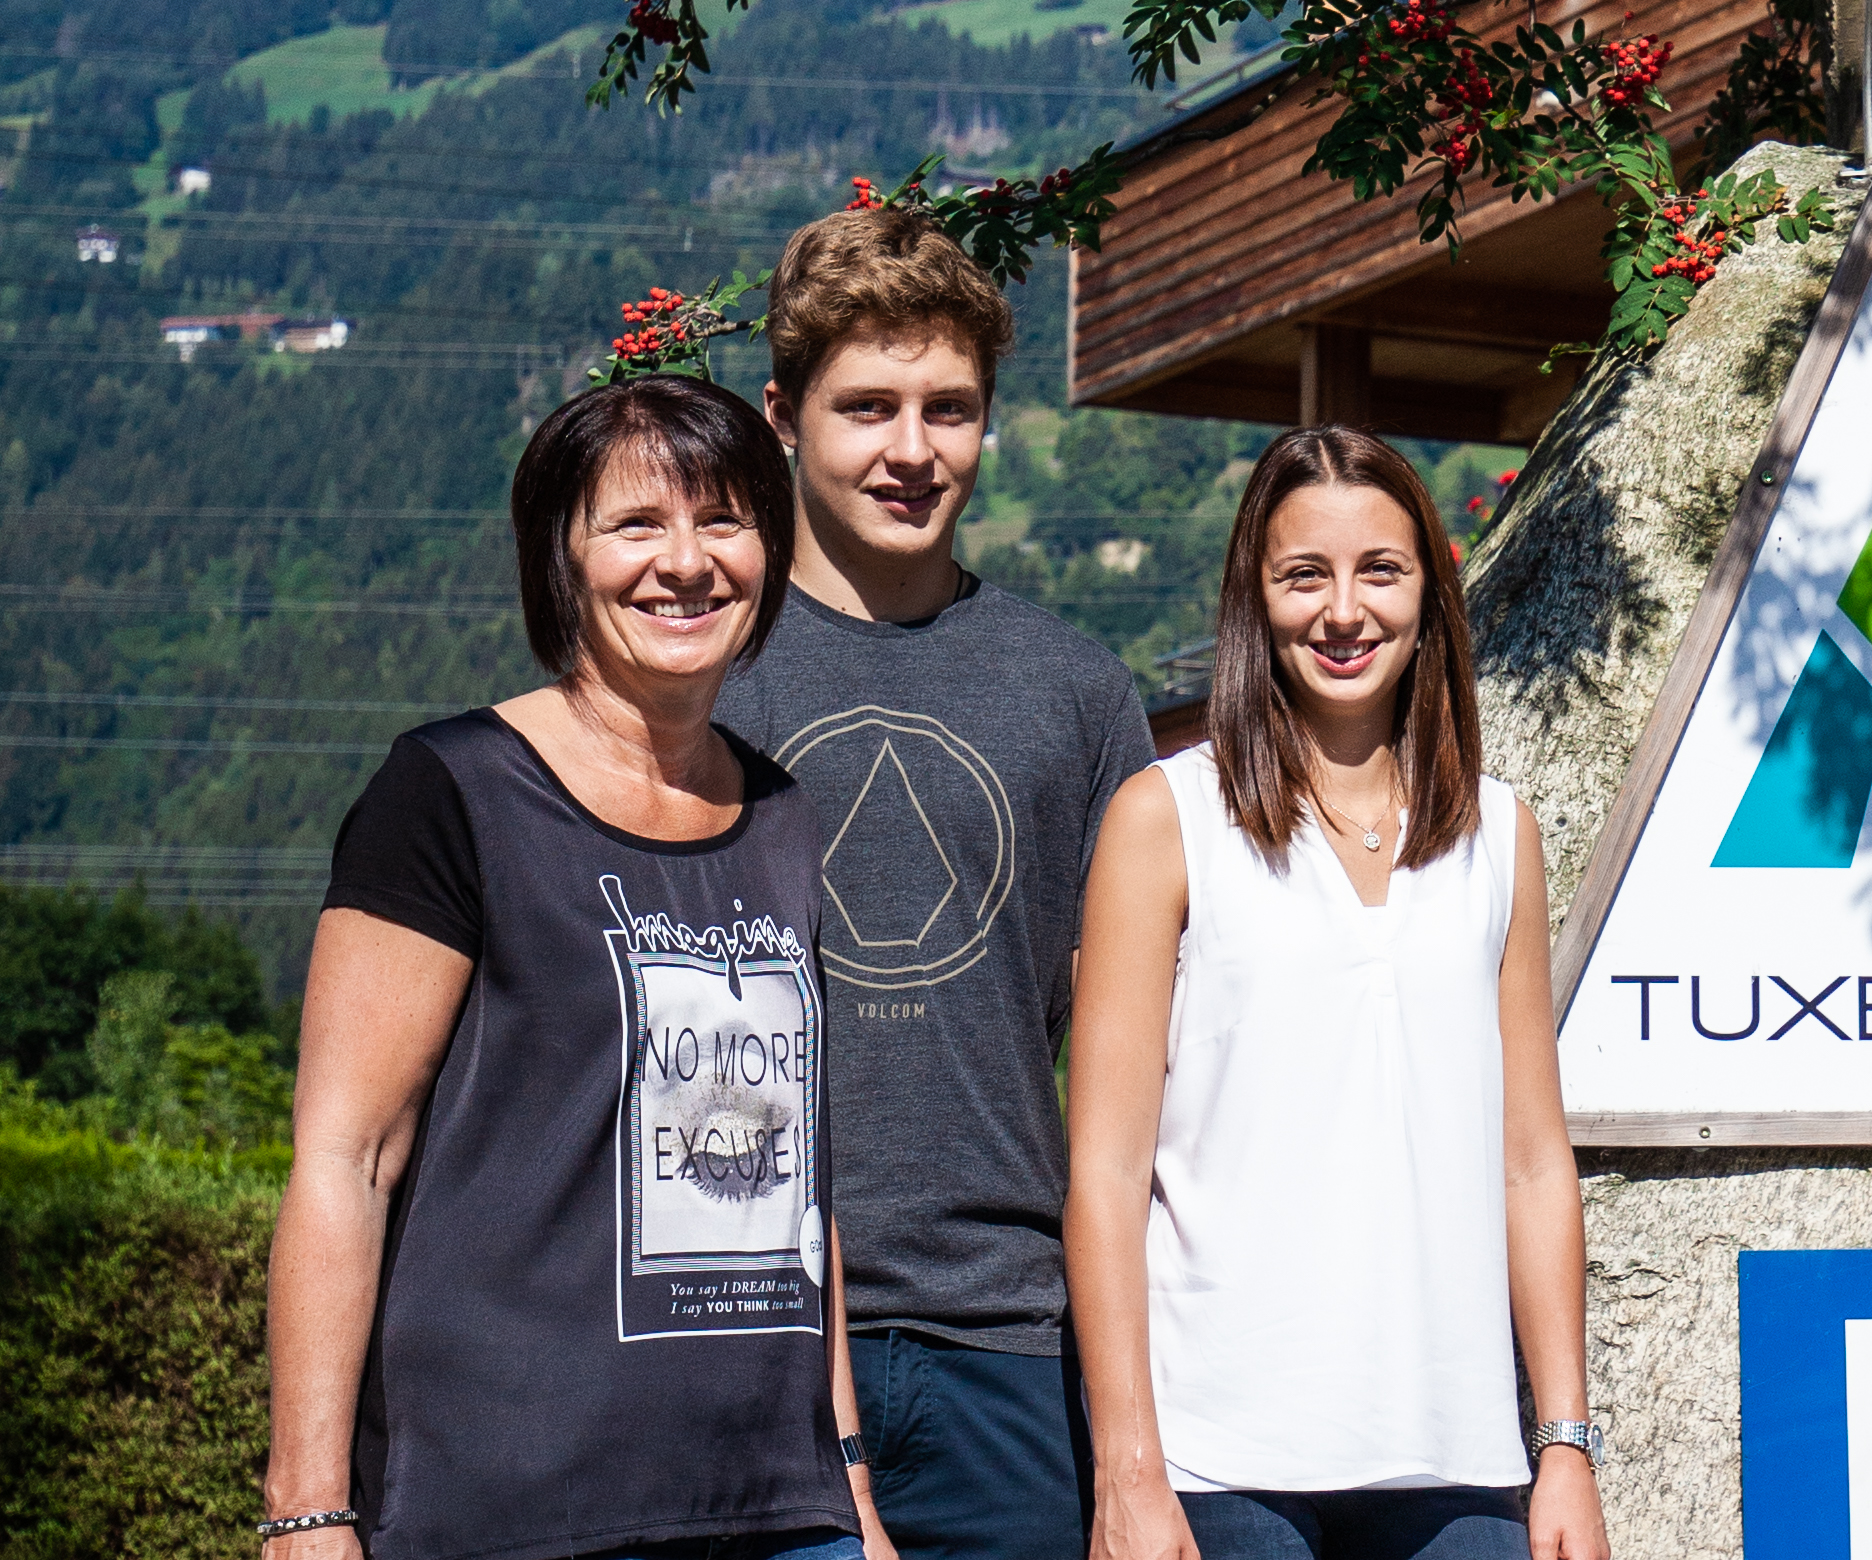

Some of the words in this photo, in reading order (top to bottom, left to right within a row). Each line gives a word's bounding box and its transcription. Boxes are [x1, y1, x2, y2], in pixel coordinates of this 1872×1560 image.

[599, 874, 807, 1002] Imagine
[857, 1002, 926, 1019] VOLCOM
[641, 1027, 699, 1082] NO
[714, 1031, 806, 1086] MORE
[655, 1125, 802, 1186] EXCUSES
[670, 1283, 694, 1296] You
[698, 1285, 719, 1299] say
[721, 1281, 729, 1294] I
[731, 1280, 776, 1294] DREAM
[670, 1301, 678, 1315] I
[681, 1304, 702, 1318] say
[706, 1301, 733, 1313] YOU
[736, 1300, 770, 1312] THINK
